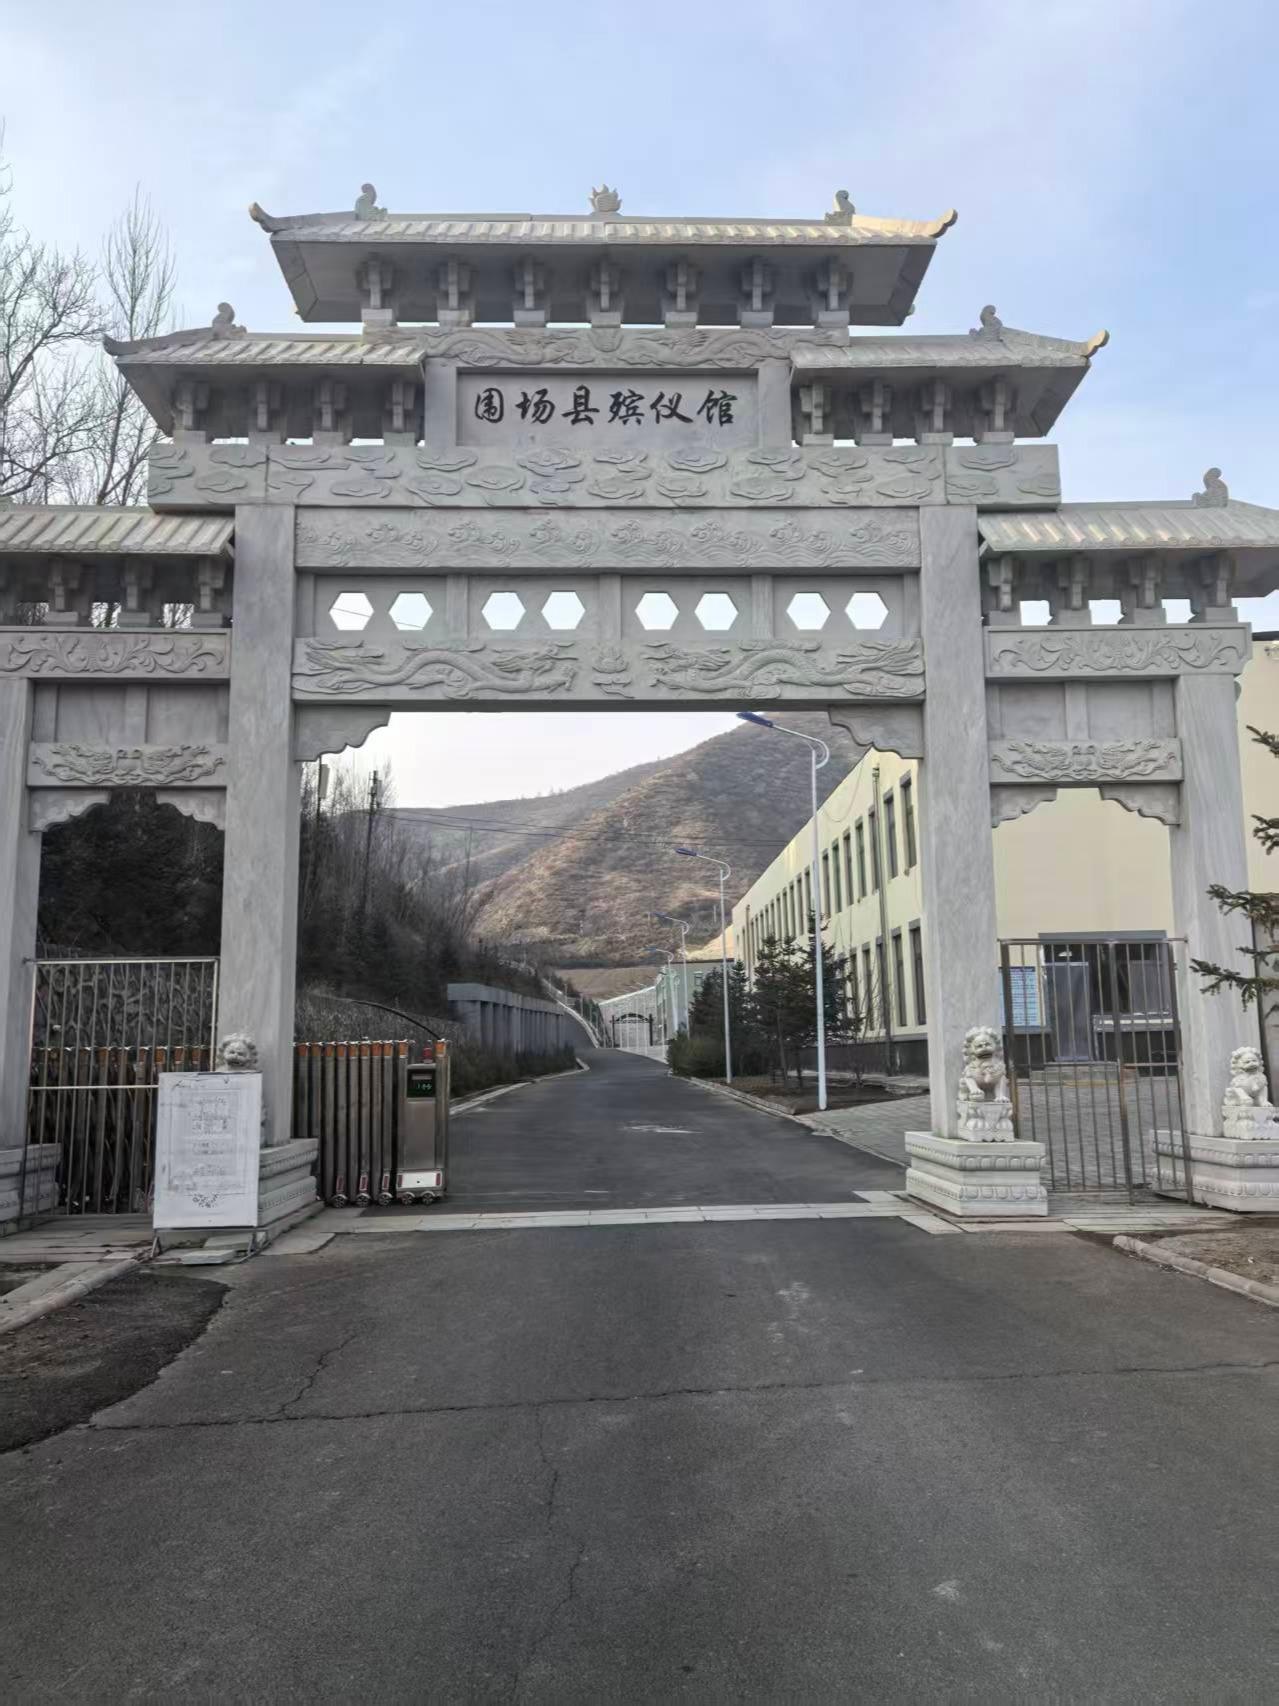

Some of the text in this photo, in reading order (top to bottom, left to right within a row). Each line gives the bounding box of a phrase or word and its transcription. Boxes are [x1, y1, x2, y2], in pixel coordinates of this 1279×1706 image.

[474, 384, 738, 427] 围场县殡仪馆
